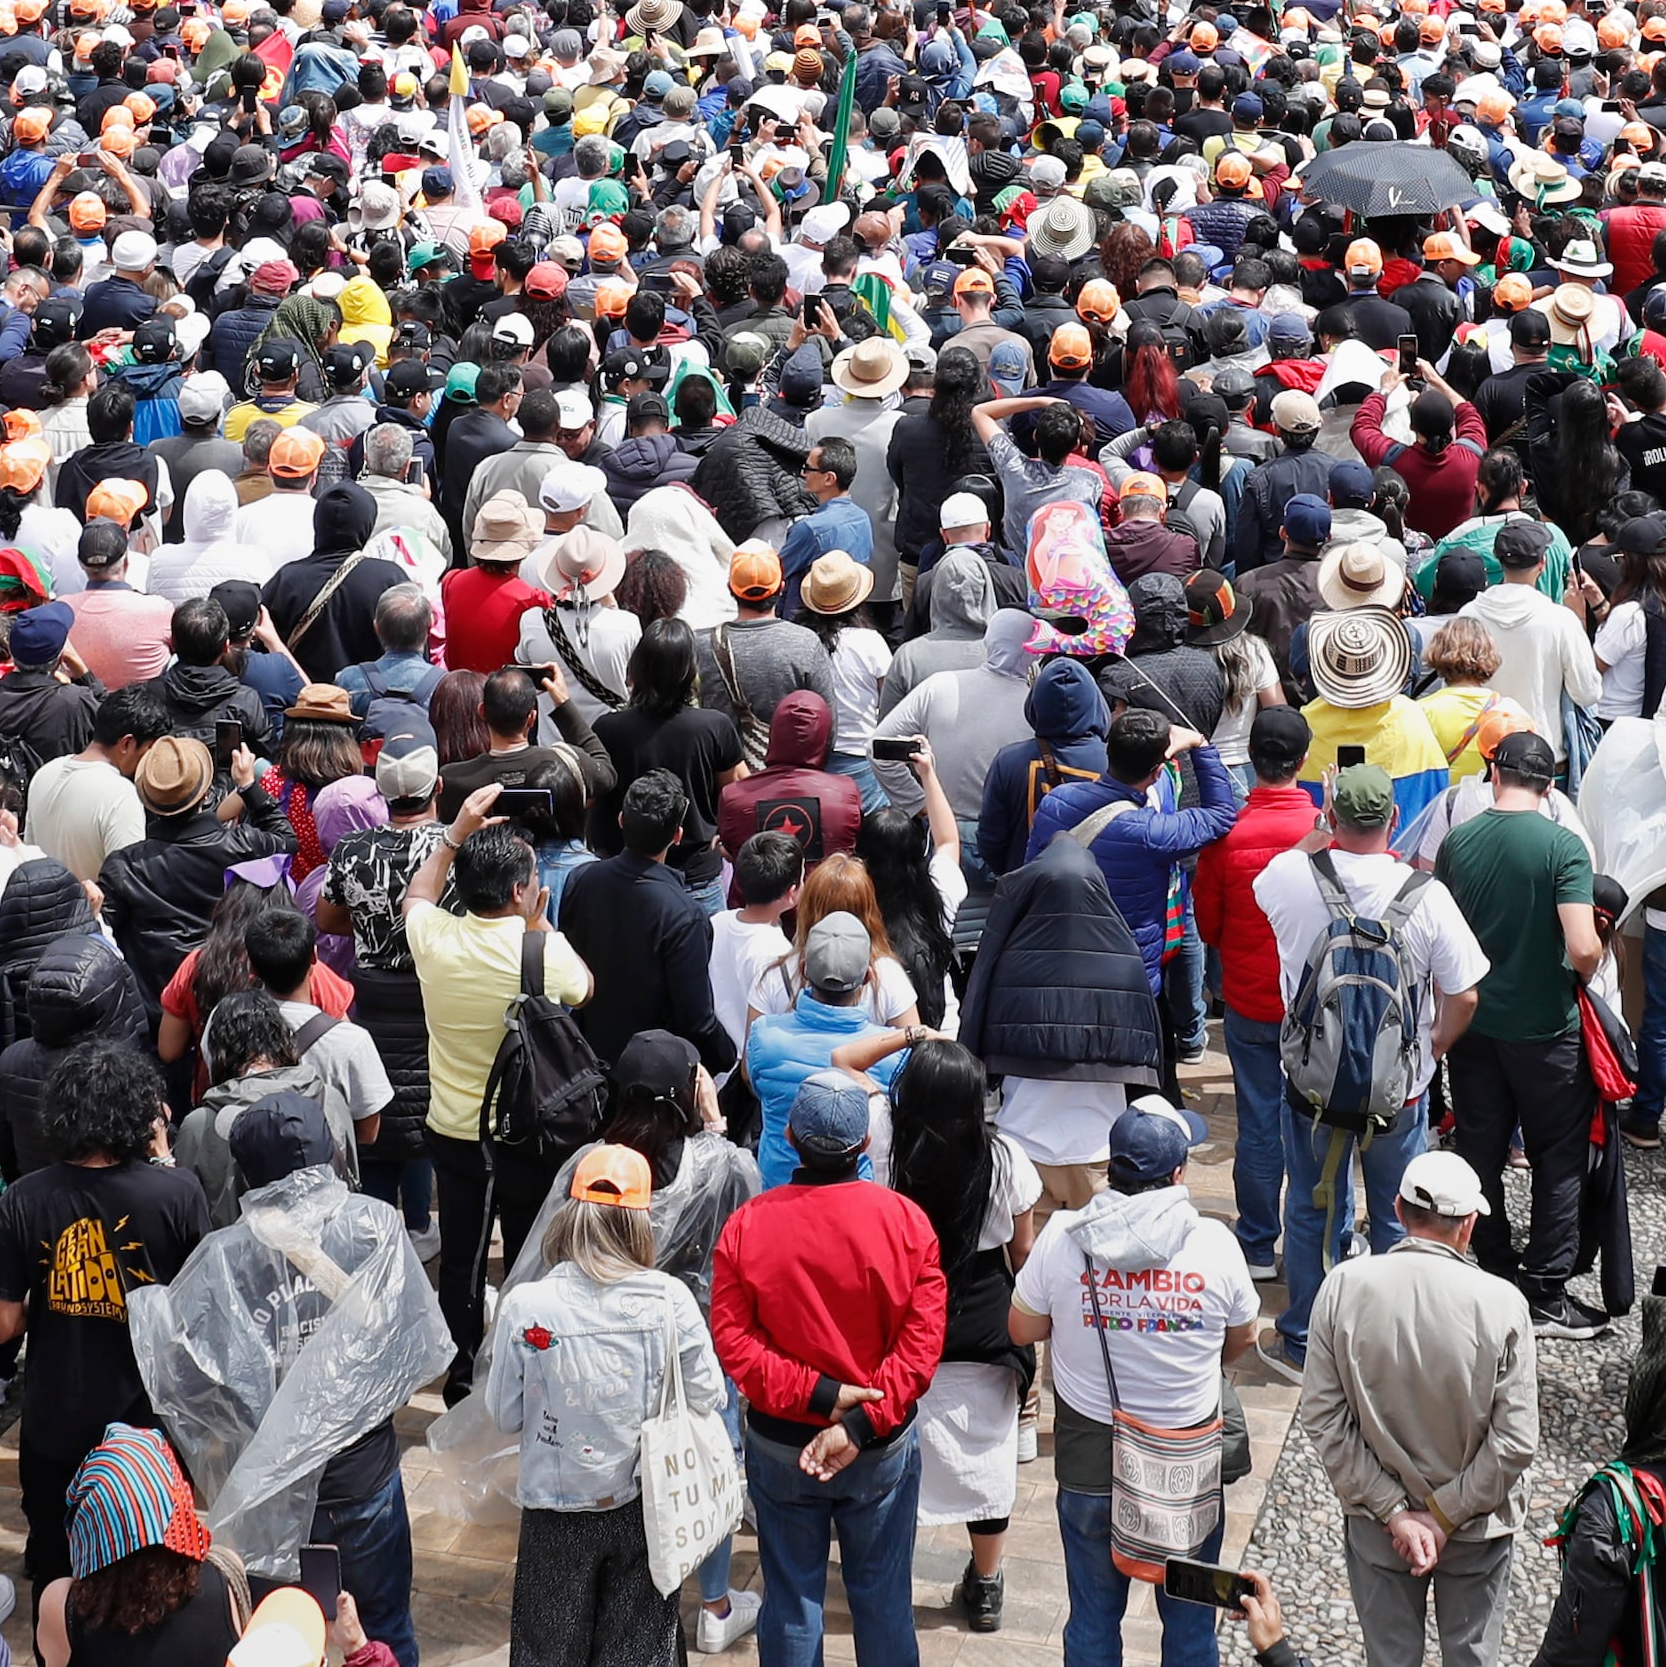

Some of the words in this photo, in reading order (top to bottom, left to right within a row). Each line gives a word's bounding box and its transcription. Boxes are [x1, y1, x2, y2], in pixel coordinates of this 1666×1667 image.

[55, 1218, 107, 1270] GRAN
[265, 1275, 320, 1311] PLAC
[1079, 1268, 1205, 1294] CAMBIO
[51, 1300, 124, 1320] SOUNDSYSTEM
[1081, 1291, 1122, 1308] POR
[1126, 1294, 1153, 1309] LA
[1155, 1295, 1203, 1312] VIDA
[1082, 1308, 1131, 1317] PRIDENTE
[664, 1447, 697, 1478] NO
[668, 1483, 700, 1513] TU
[674, 1511, 717, 1549] SOY
